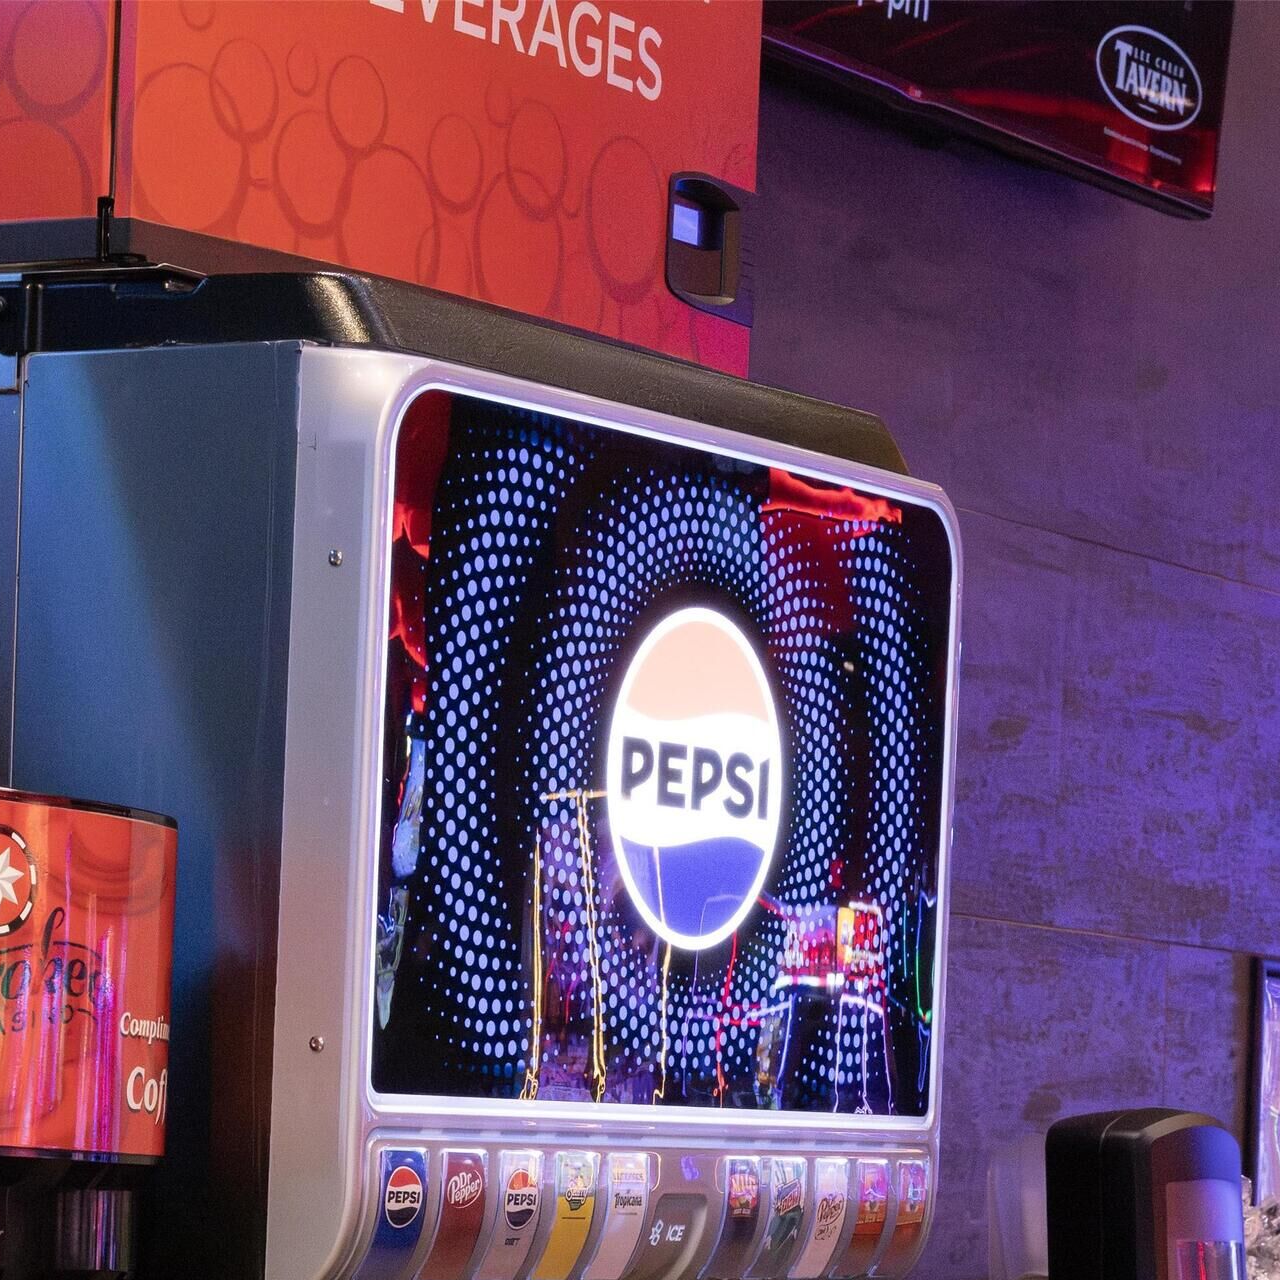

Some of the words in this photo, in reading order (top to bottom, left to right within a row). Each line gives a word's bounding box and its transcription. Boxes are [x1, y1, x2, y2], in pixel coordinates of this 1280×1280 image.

[1114, 39, 1188, 116] TAVERN
[622, 736, 771, 821] PEPSI
[387, 1190, 421, 1205] PEPSI
[448, 1175, 481, 1205] Pepper
[507, 1193, 537, 1207] PEPSI
[666, 1224, 686, 1242] ICE
